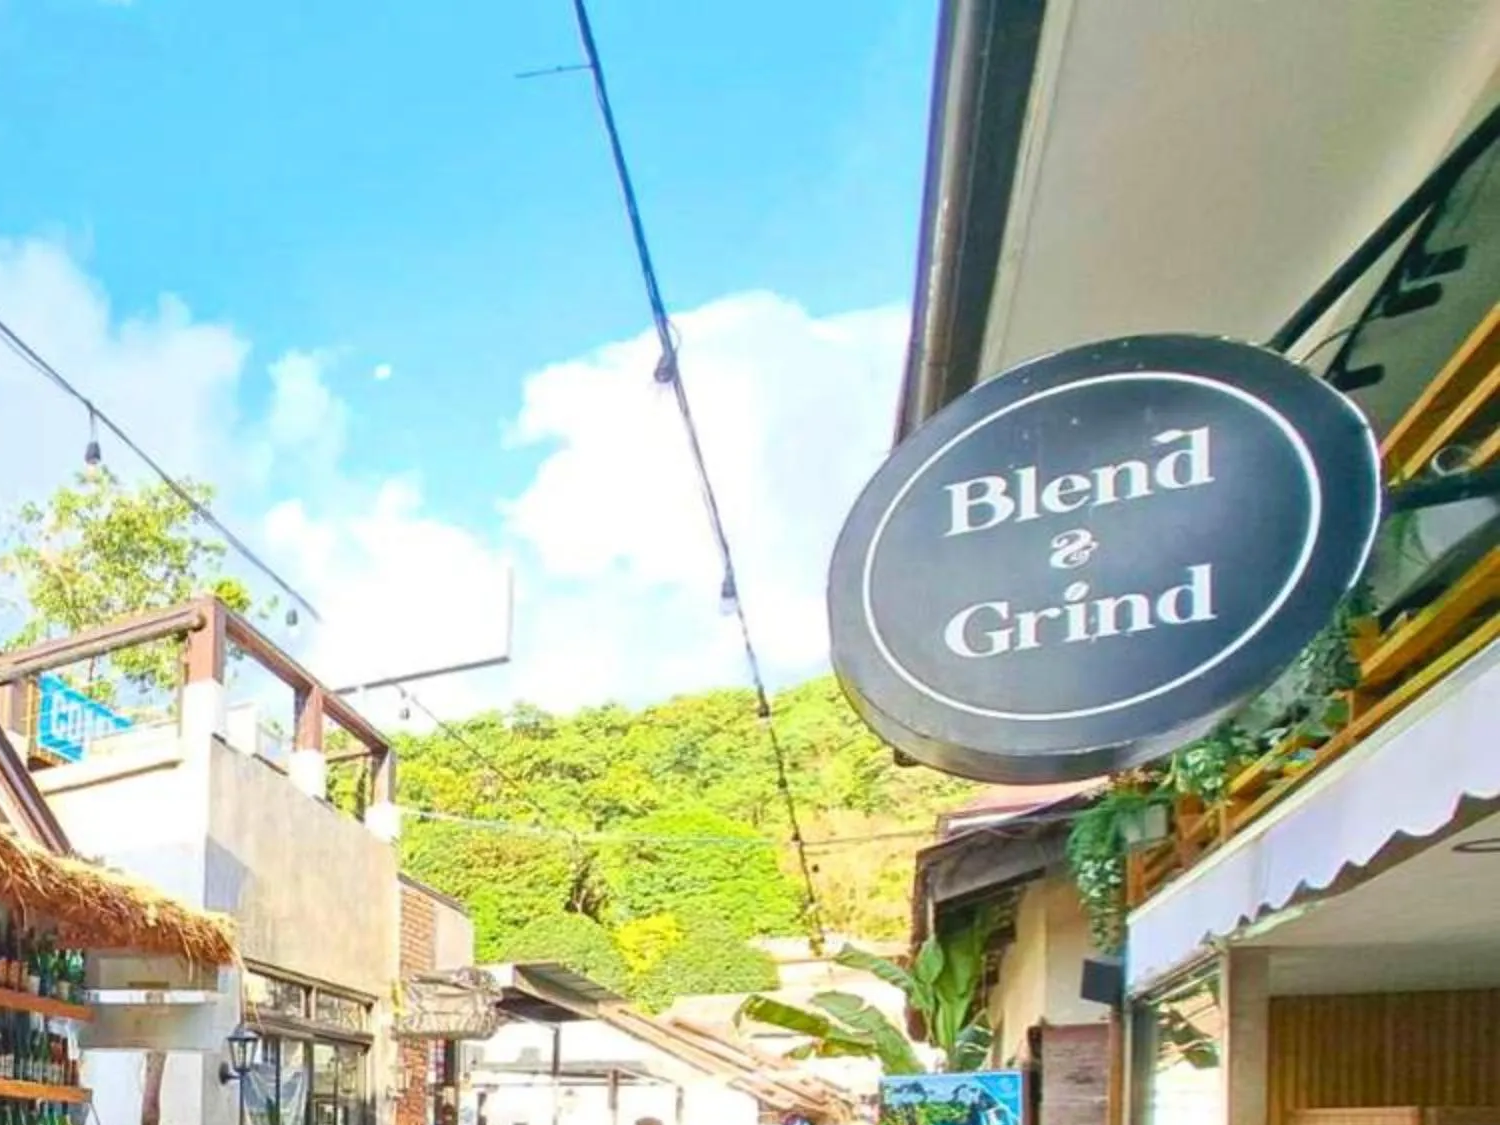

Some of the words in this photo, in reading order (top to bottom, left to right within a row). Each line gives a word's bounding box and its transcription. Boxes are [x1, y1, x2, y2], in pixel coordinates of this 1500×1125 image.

[944, 427, 1216, 537] Blend
[1049, 529, 1098, 568] &
[944, 564, 1217, 660] Grind
